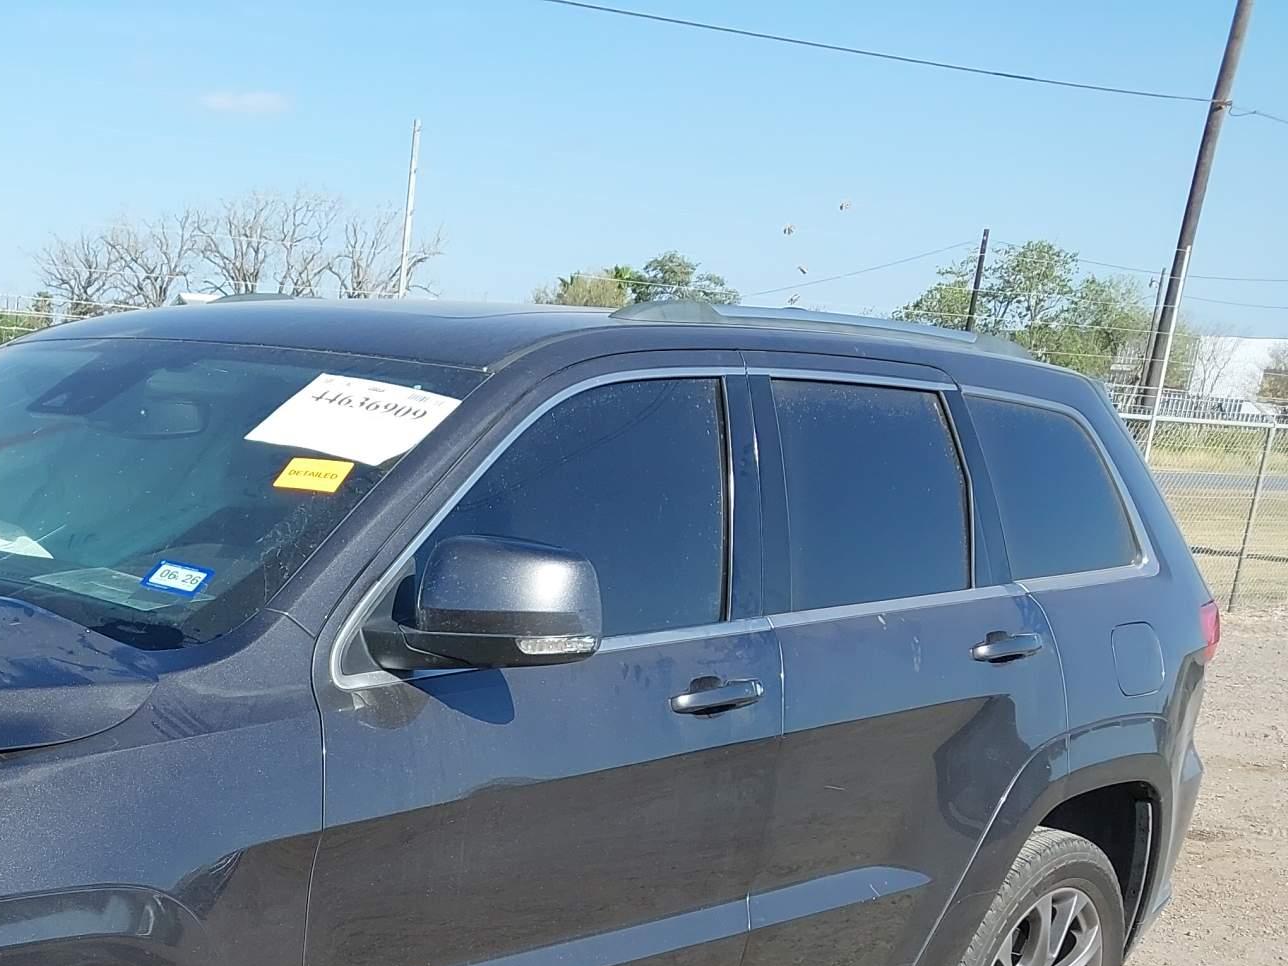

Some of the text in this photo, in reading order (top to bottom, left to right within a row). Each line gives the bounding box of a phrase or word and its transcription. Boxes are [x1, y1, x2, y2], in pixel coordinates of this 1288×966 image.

[312, 390, 427, 420] 44636909
[288, 469, 338, 480] DETAILED
[182, 574, 201, 585] 26
